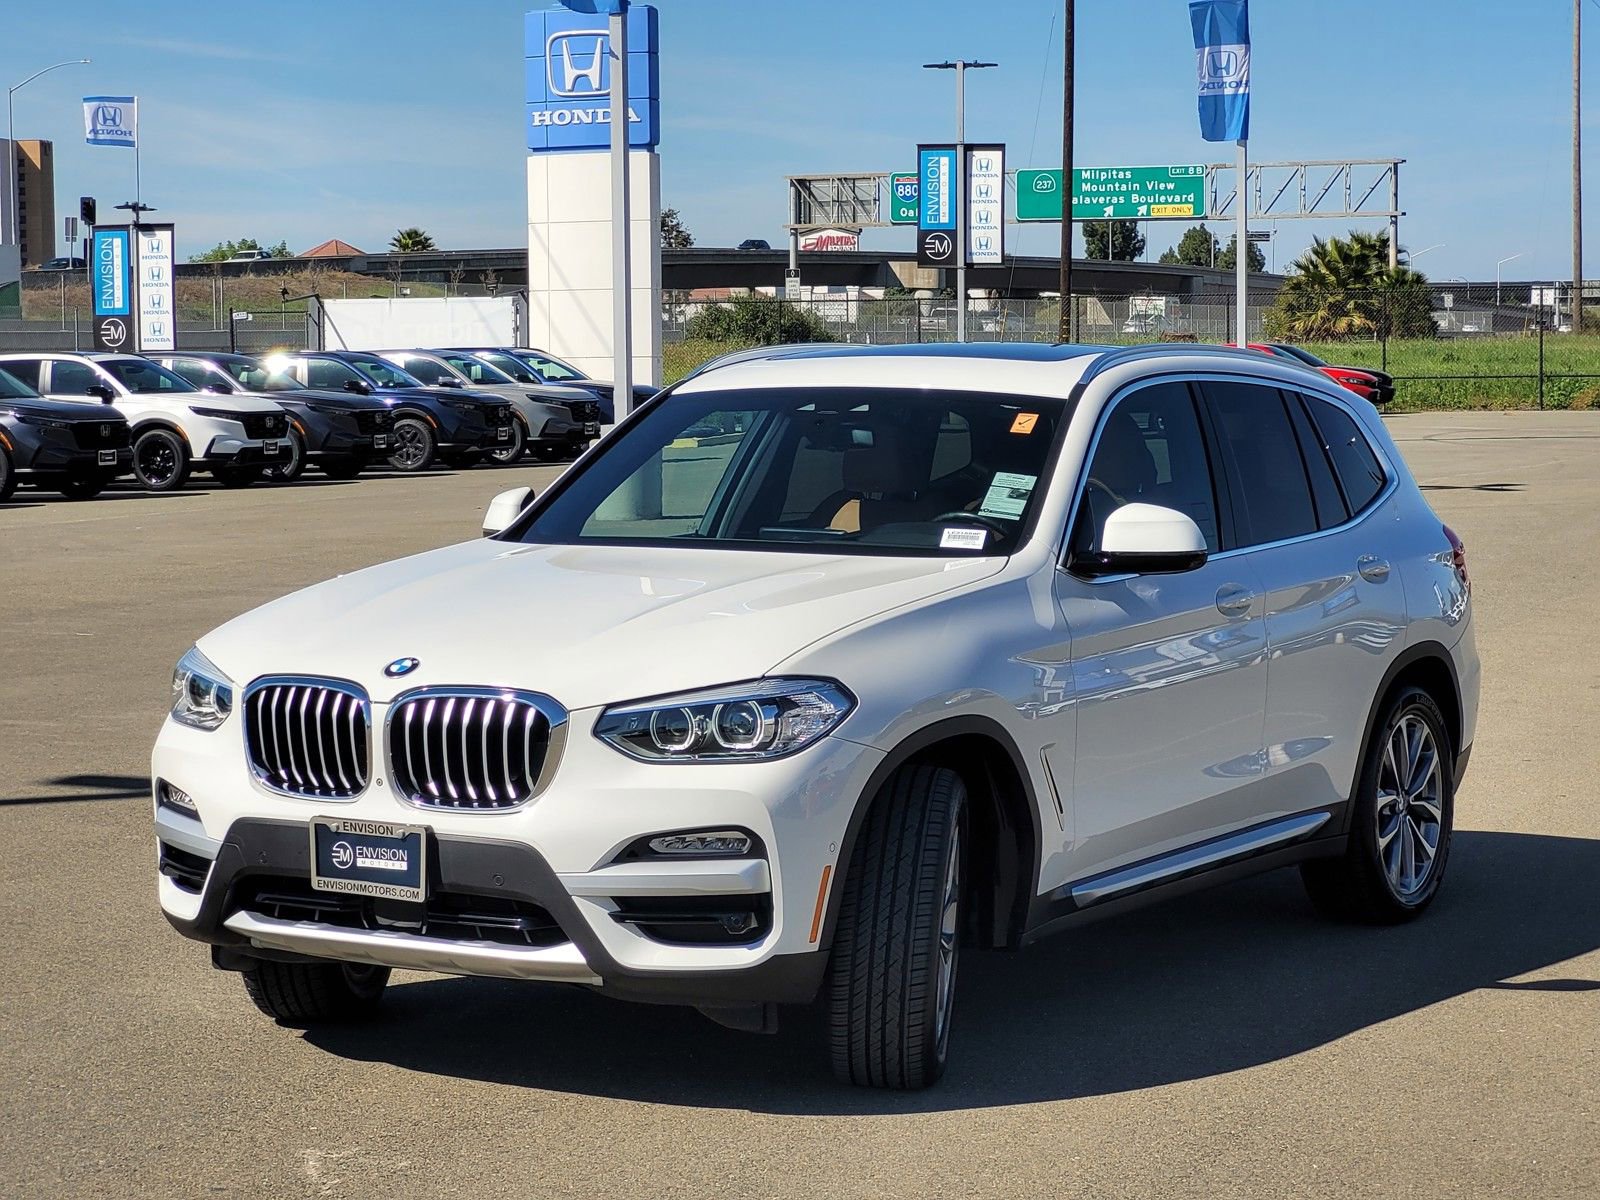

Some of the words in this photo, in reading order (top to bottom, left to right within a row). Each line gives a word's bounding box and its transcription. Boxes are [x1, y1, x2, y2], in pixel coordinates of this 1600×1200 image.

[1081, 169, 1132, 181] Milpitas
[927, 156, 940, 224] ENVISION
[1036, 180, 1052, 189] 237
[1081, 182, 1140, 192] Mountain
[1146, 180, 1175, 191] View
[1072, 194, 1125, 204] alaveras
[1131, 193, 1194, 204] Boulevard
[1151, 206, 1169, 214] EXIT
[1171, 206, 1192, 214] ONLY
[100, 237, 113, 310] ENVISION
[342, 821, 394, 836] ENVISION
[355, 846, 408, 861] ENVISION
[317, 879, 420, 899] ENVISIONMOTORS.COM
